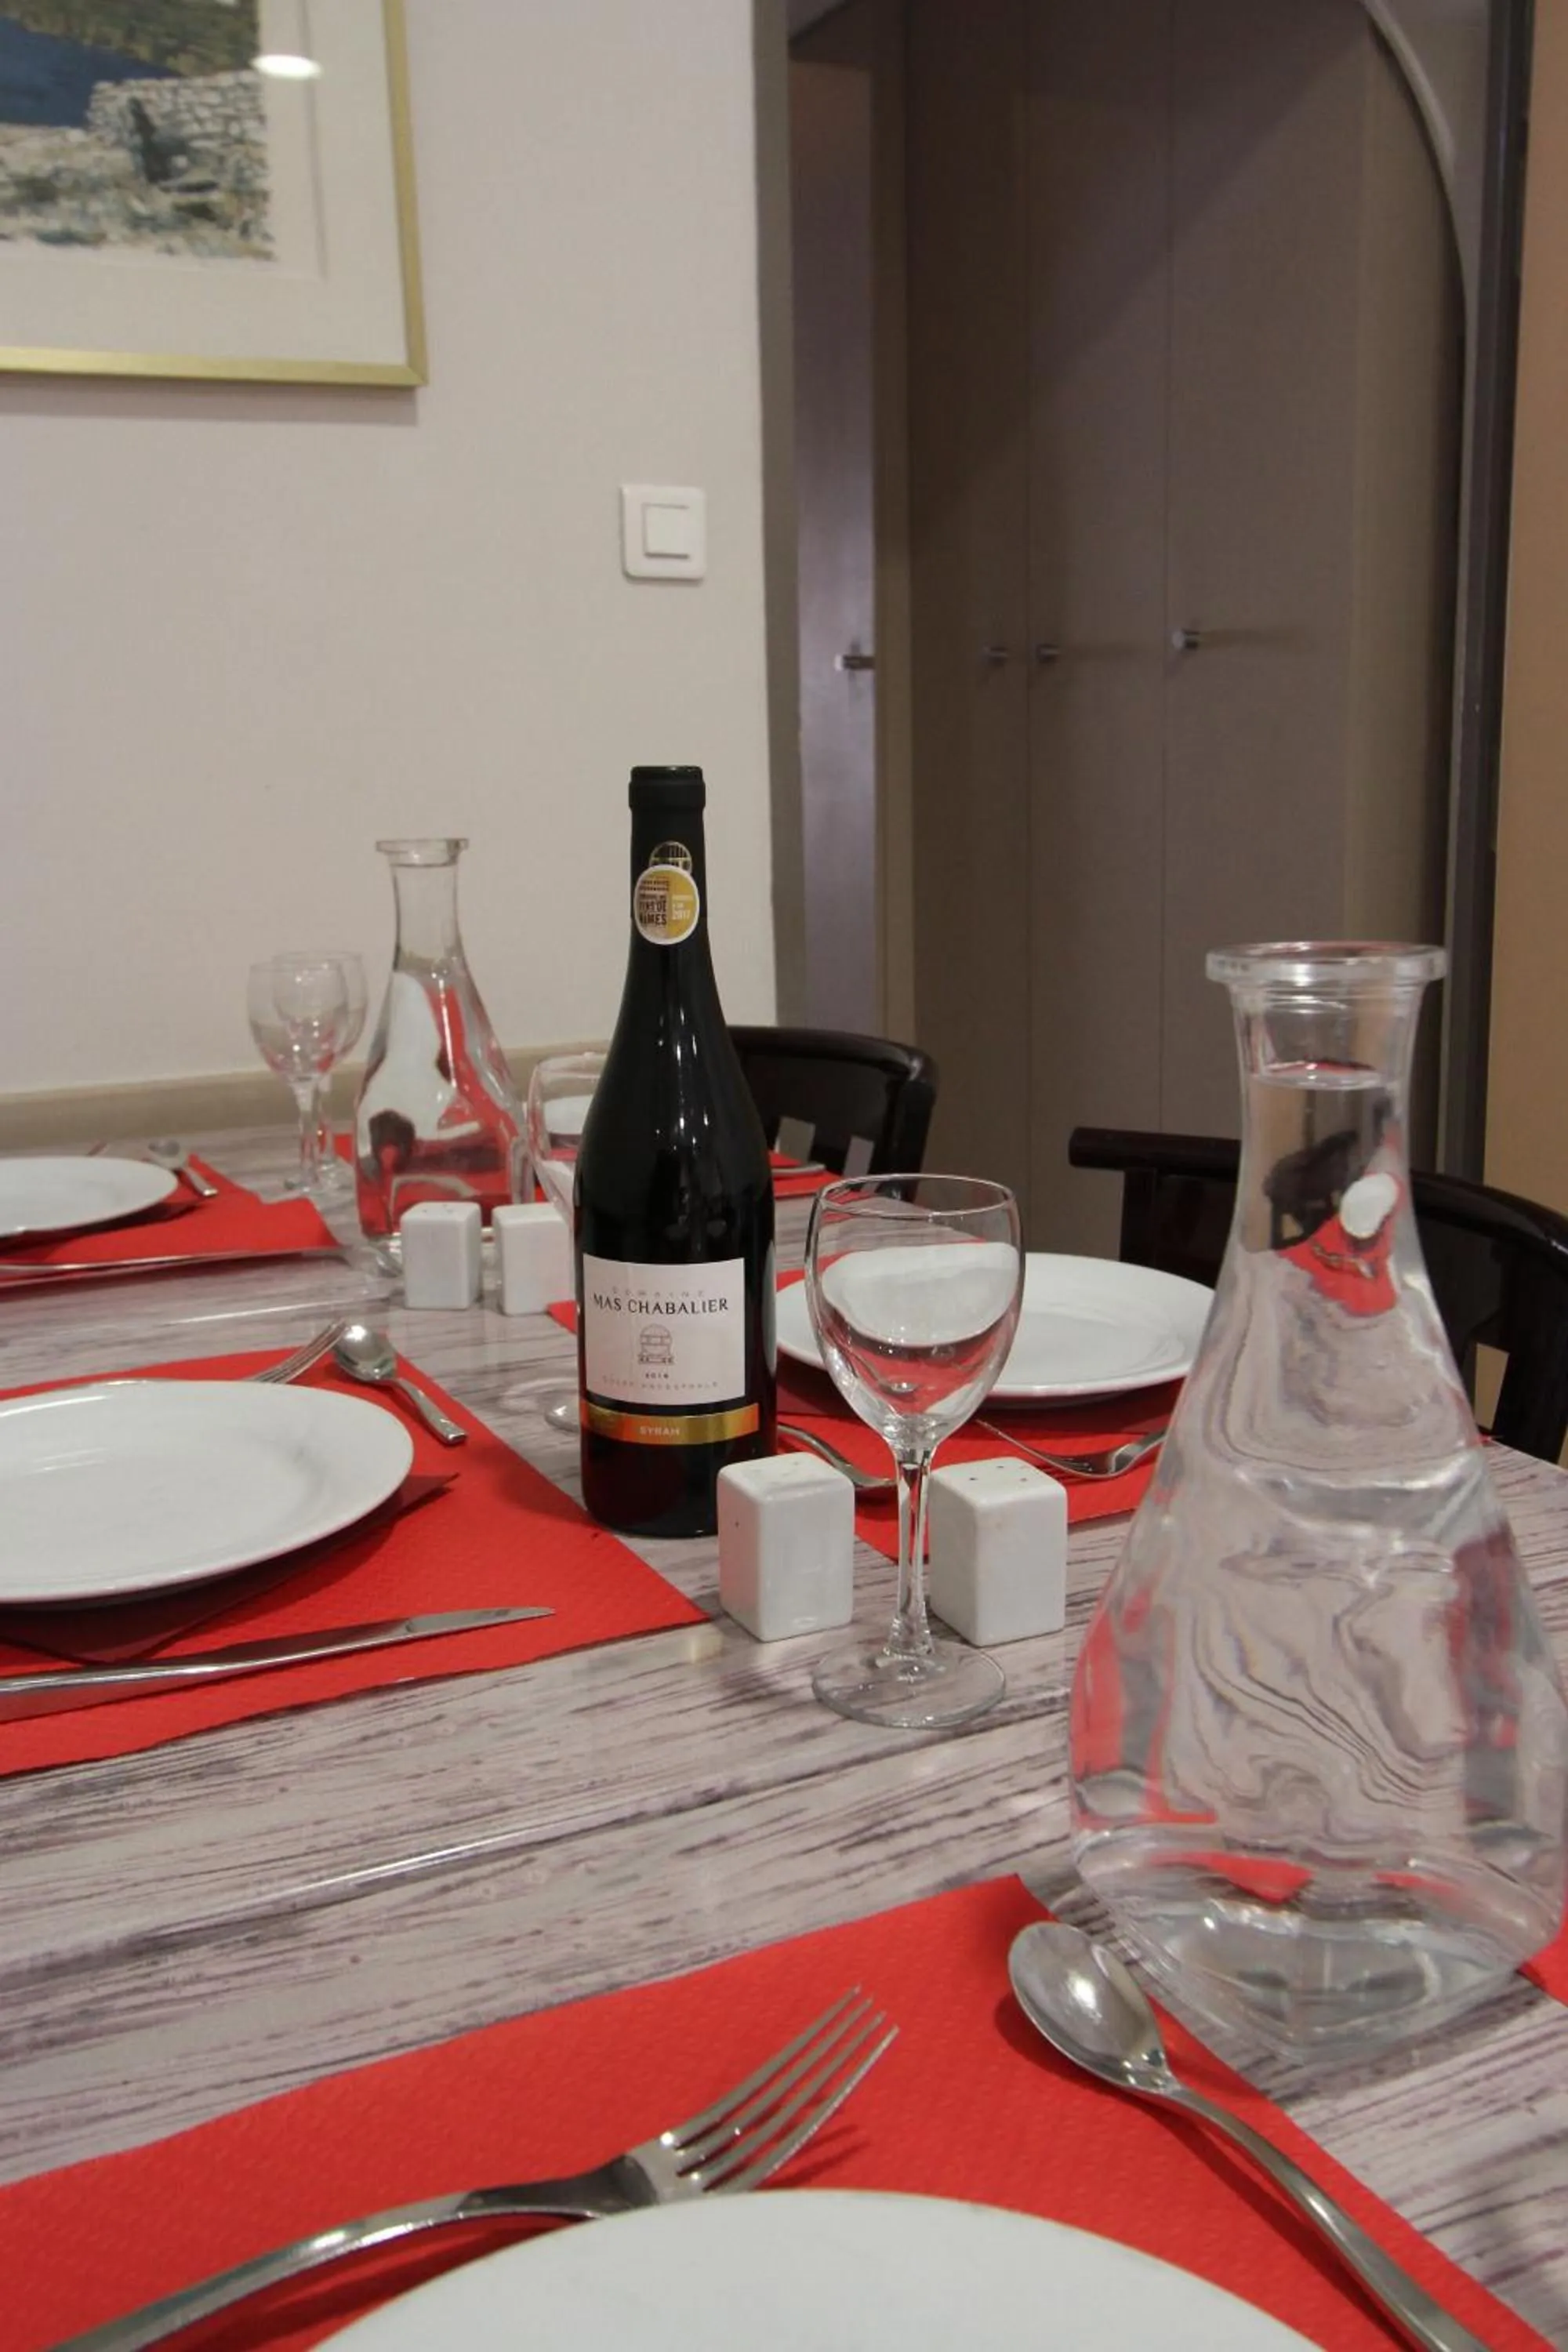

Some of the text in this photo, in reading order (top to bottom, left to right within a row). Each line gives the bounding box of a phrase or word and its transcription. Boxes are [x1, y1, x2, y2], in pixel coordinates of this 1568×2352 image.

[593, 1292, 728, 1315] MAS CHABALIER
[639, 1426, 681, 1436] SYRAH
